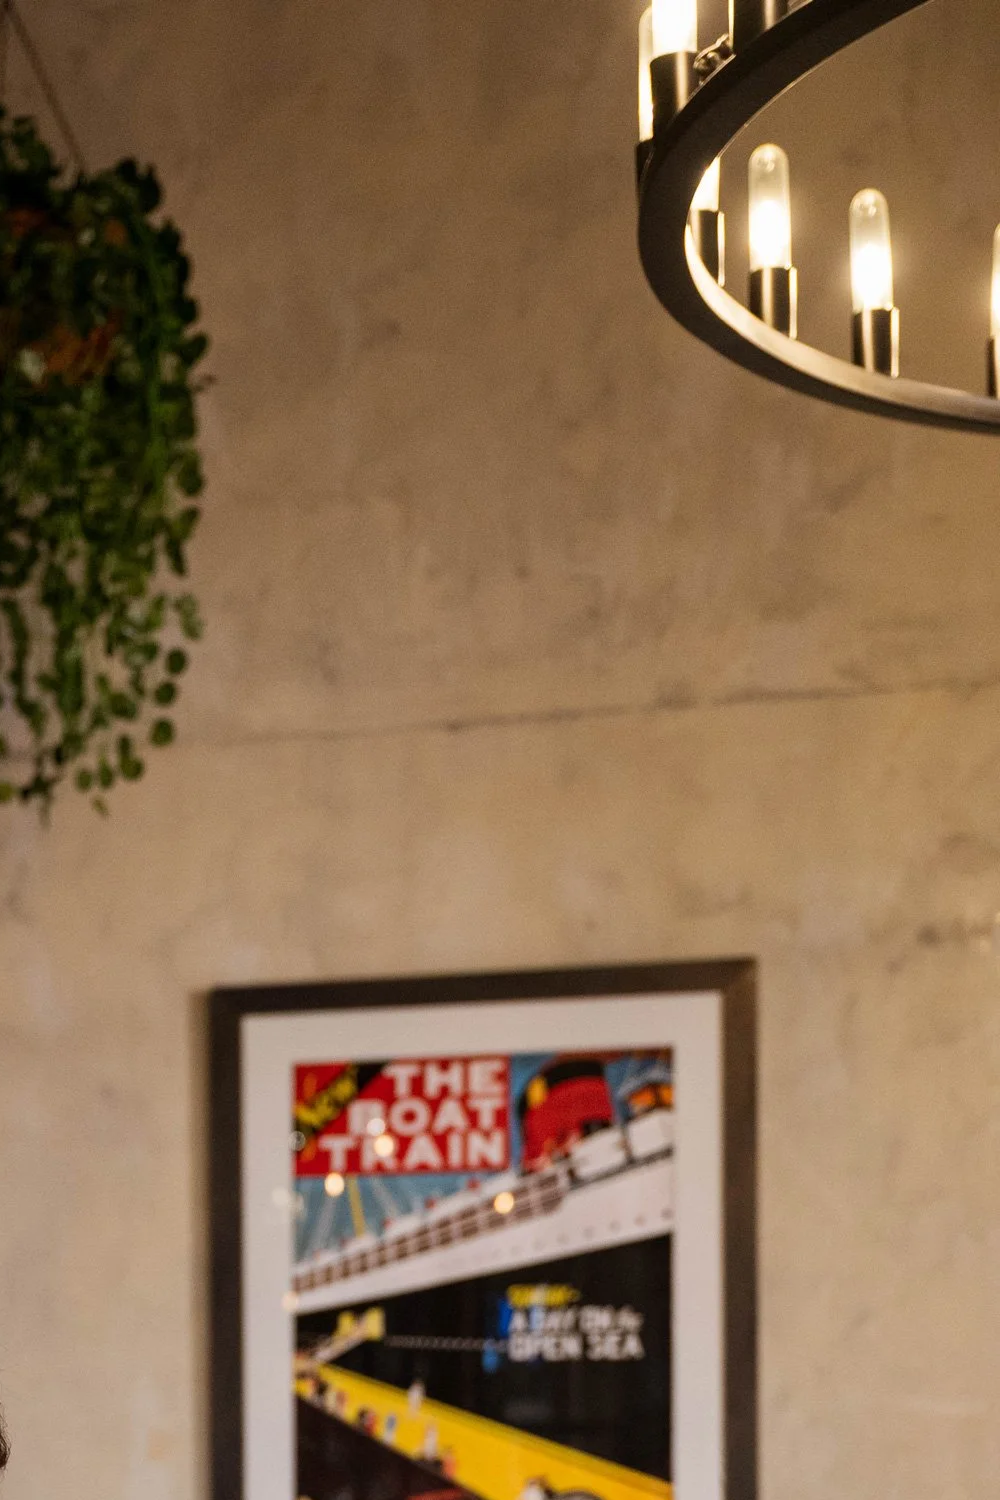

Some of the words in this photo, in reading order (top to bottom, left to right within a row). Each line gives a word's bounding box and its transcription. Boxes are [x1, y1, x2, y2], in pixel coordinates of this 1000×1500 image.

[383, 1061, 504, 1098] THE
[346, 1097, 505, 1136] BOAT
[319, 1131, 504, 1172] TRAIN
[586, 1333, 646, 1362] SEA
